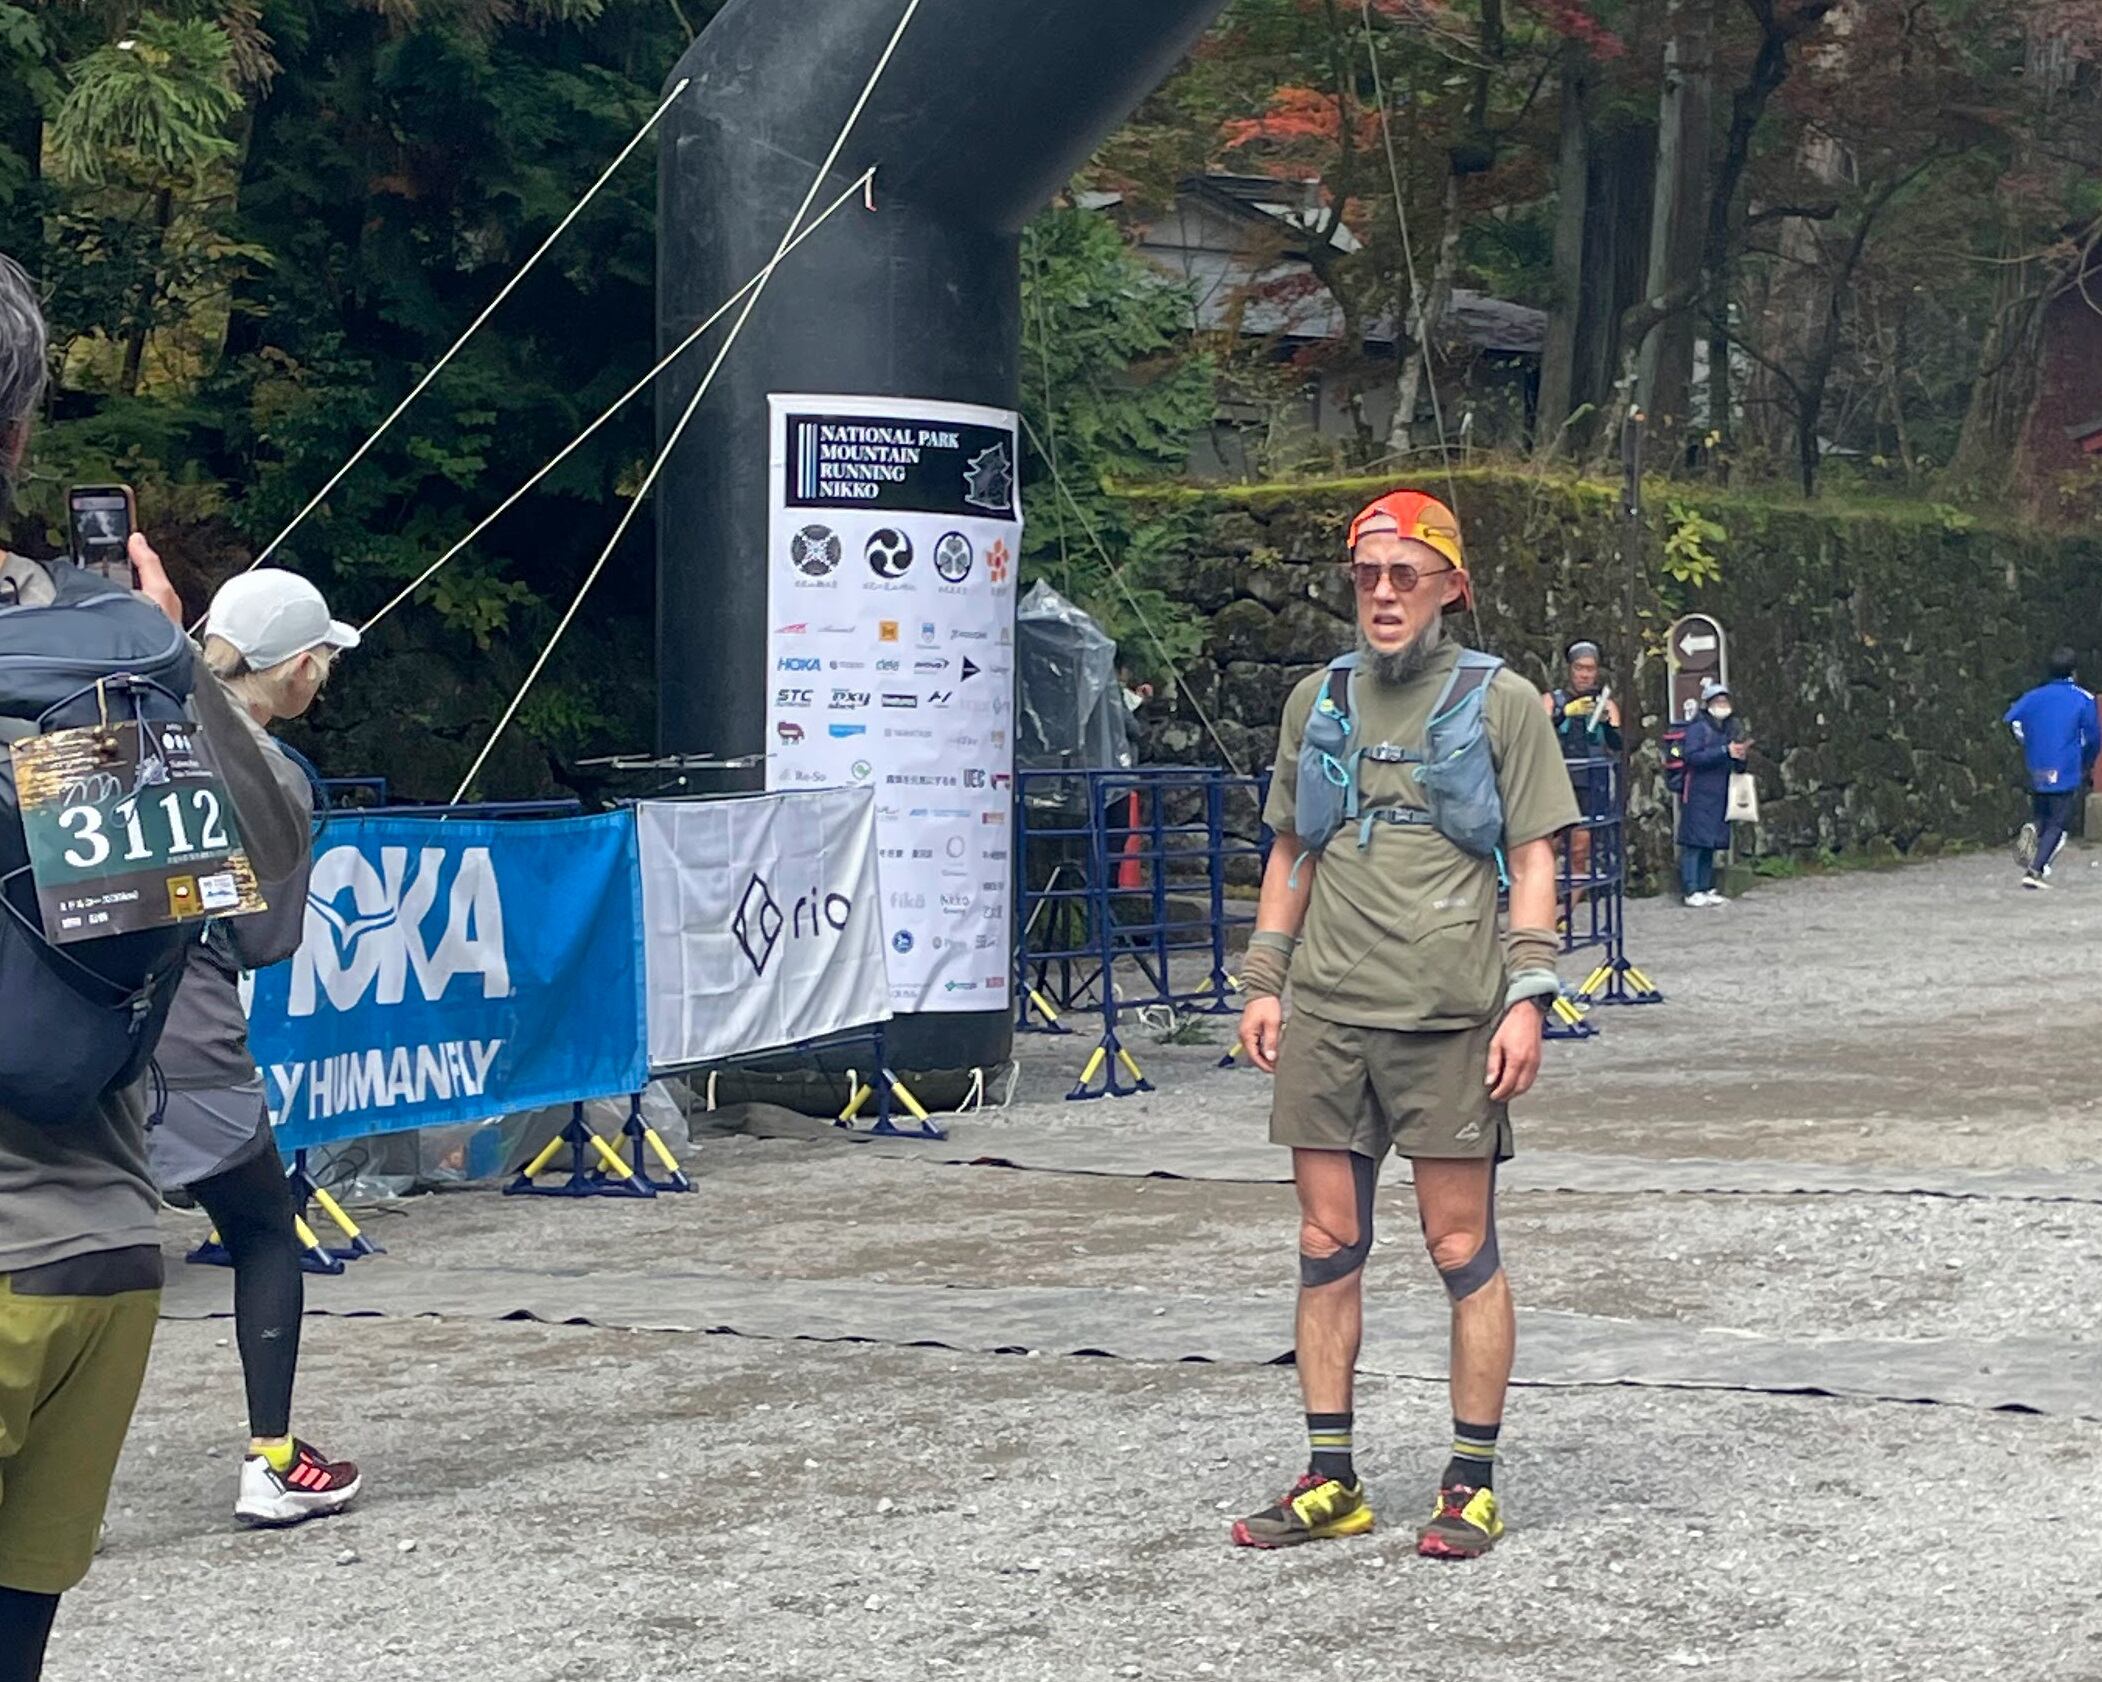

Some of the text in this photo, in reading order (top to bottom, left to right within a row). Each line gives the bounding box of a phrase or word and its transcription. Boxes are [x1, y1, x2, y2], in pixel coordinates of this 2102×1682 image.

[820, 425, 960, 449] NATIONAL PARK
[820, 445, 920, 464] MOUNTAIN
[820, 463, 906, 482] RUNNING
[819, 481, 880, 498] NIKKO
[777, 657, 821, 671] HOKA
[777, 689, 814, 702] STC
[58, 789, 229, 868] 3112
